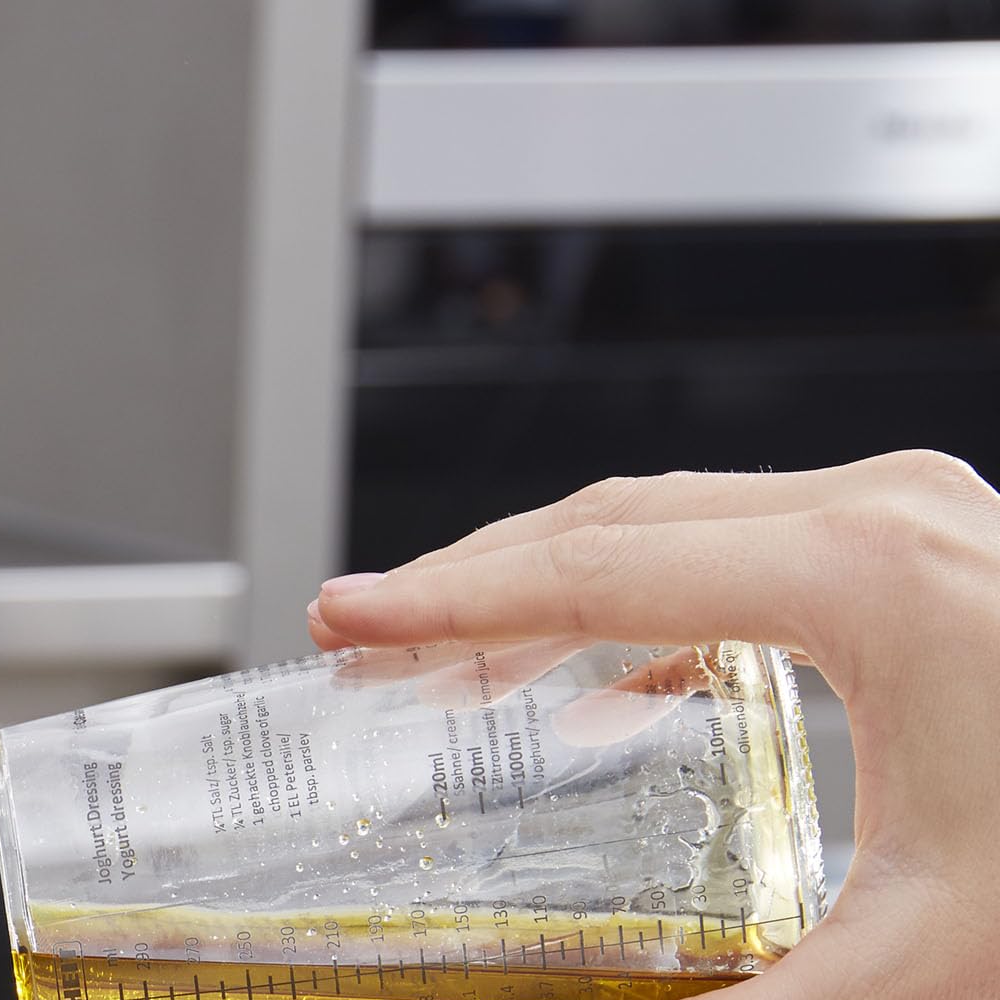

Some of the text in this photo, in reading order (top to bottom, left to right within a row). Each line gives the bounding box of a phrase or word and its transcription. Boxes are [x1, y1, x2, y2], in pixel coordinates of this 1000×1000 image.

[728, 666, 741, 693] olive
[253, 695, 270, 718] garlic
[474, 652, 503, 788] Zitronensaft/ lemon juice
[220, 713, 231, 735] sugar
[235, 691, 254, 760] Knoblauchzehe/
[256, 719, 268, 729] of
[521, 688, 545, 784] Joghurt/ yogurt
[706, 716, 727, 757] 10ml
[730, 698, 751, 754] Olivenöl/
[201, 734, 213, 753] Salt
[222, 737, 235, 755] tsp.
[260, 729, 272, 757] clove
[445, 709, 465, 793] Sahne/ cream
[505, 731, 526, 781] 100ml
[207, 755, 218, 776] tsp.
[222, 758, 240, 801] Zucker/
[276, 733, 301, 819] 1 EL Petersilie/
[300, 733, 319, 805] tbsp. parsley
[428, 752, 448, 794] 20ml
[467, 746, 487, 789] 20ml
[206, 779, 221, 805] Salz/
[246, 763, 264, 815] gehackte
[262, 760, 281, 812] chopped
[82, 762, 112, 884] Joghurt Dressing
[107, 762, 135, 880] Yogurt dressing
[213, 808, 223, 822] TL
[232, 803, 242, 817] TL
[253, 817, 264, 825] 1
[651, 890, 666, 910] 50
[692, 884, 707, 903] 30
[733, 878, 748, 897] 10
[454, 905, 469, 933] 150
[492, 900, 509, 928] 130
[532, 895, 548, 923] 110
[573, 901, 588, 920] 90
[611, 896, 627, 915] 70
[324, 921, 341, 949] 210
[368, 915, 384, 943] 190
[411, 909, 427, 937] 170
[237, 931, 253, 960] 250
[280, 926, 297, 954] 230
[103, 948, 119, 967] ml
[135, 943, 150, 971] 290
[740, 953, 754, 972] 0.3
